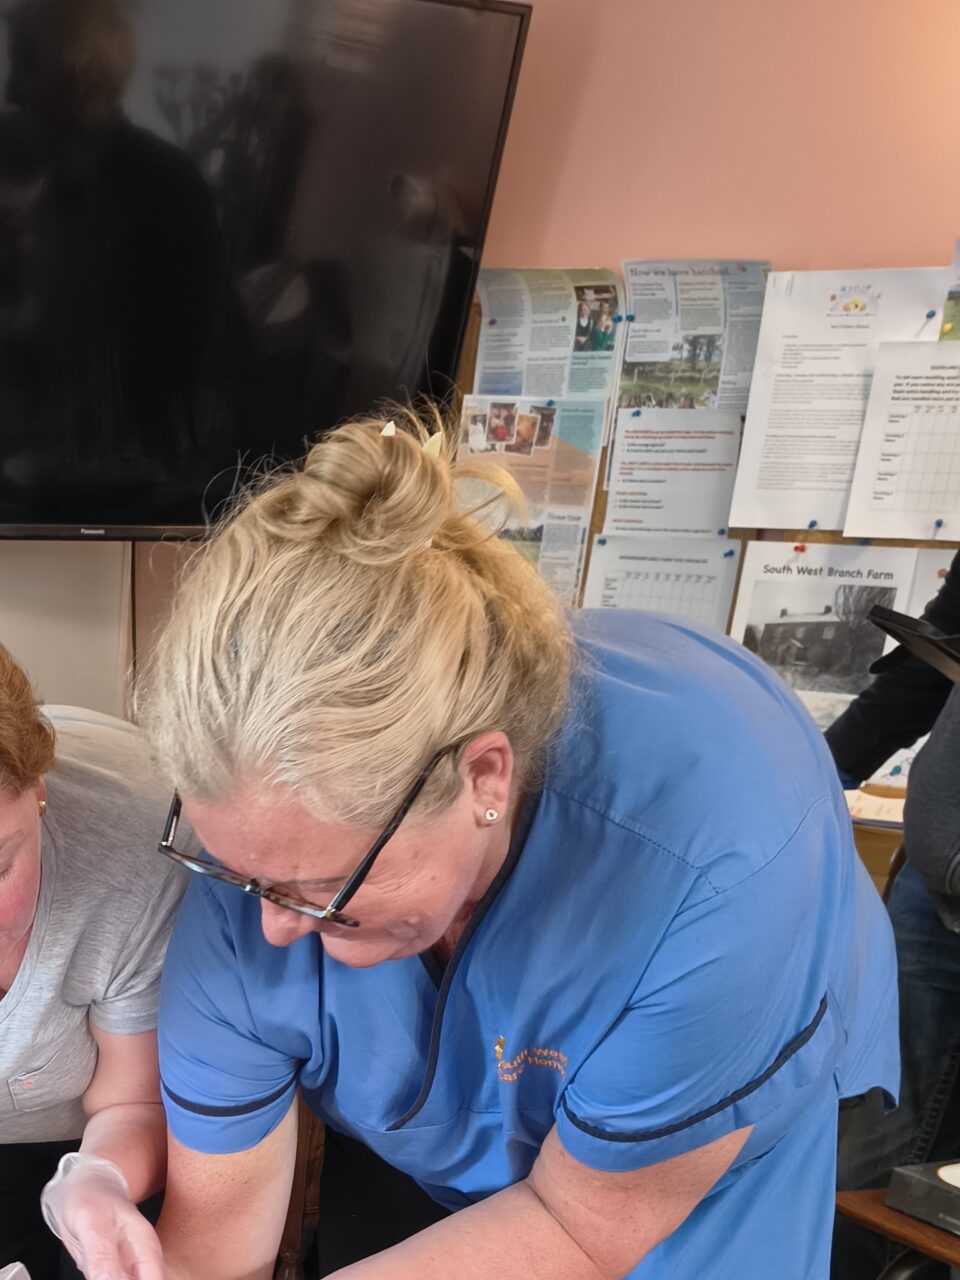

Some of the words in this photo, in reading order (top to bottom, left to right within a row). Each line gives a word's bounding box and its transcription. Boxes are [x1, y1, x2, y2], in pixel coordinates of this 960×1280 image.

[762, 564, 793, 575] South
[796, 565, 825, 577] West
[827, 567, 863, 579] Branch
[866, 569, 894, 580] Farm
